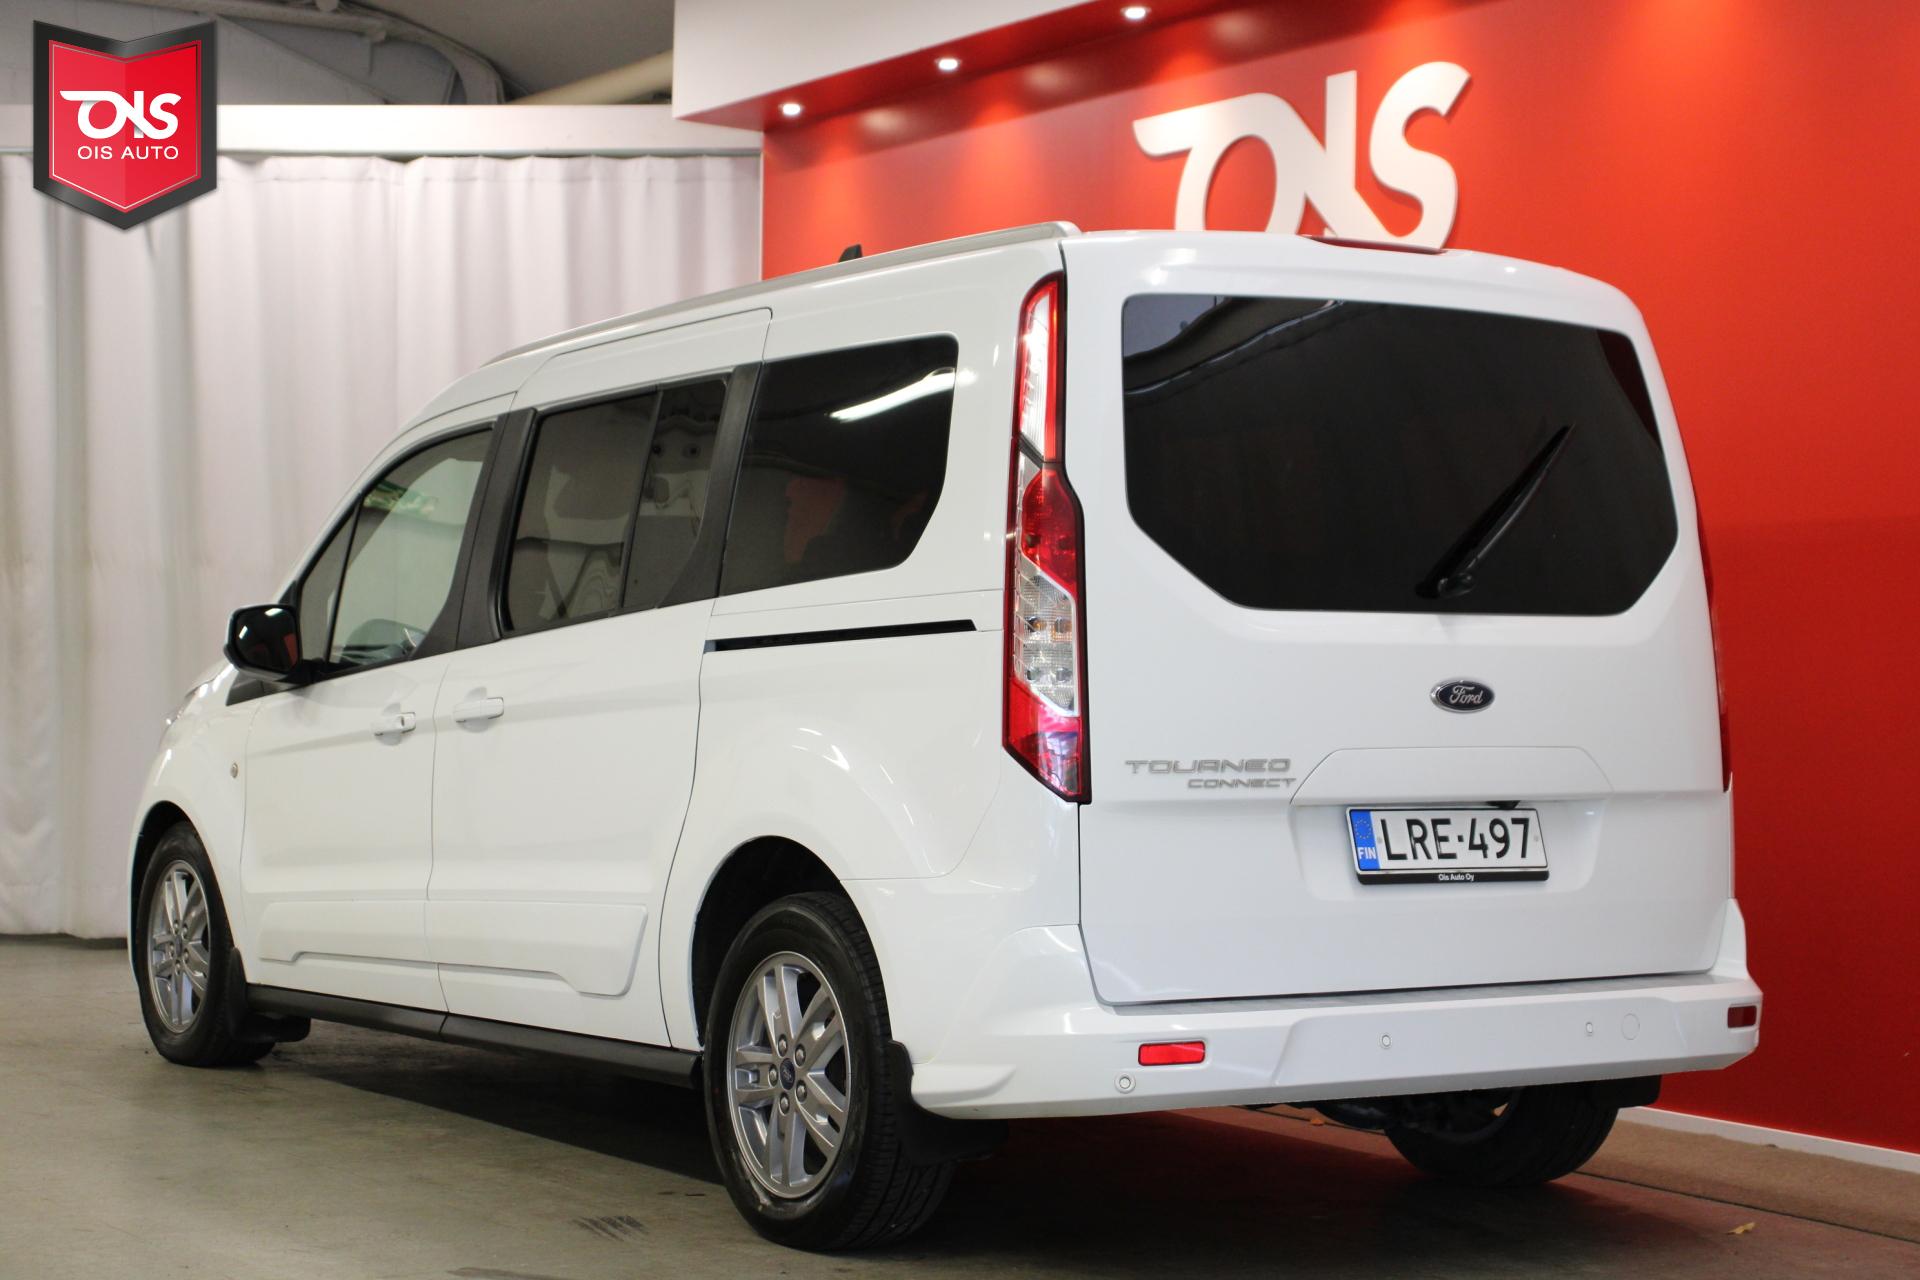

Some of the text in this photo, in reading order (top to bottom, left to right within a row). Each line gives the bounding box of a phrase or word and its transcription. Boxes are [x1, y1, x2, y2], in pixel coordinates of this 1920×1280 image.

[1449, 685, 1483, 704] Ford
[1125, 758, 1291, 774] TOURNEO
[1187, 778, 1297, 789] CONNECT
[1380, 817, 1530, 860] LRE-497
[1357, 847, 1376, 860] FIN
[1450, 873, 1464, 881] Auto
[1465, 873, 1474, 881] Oy
